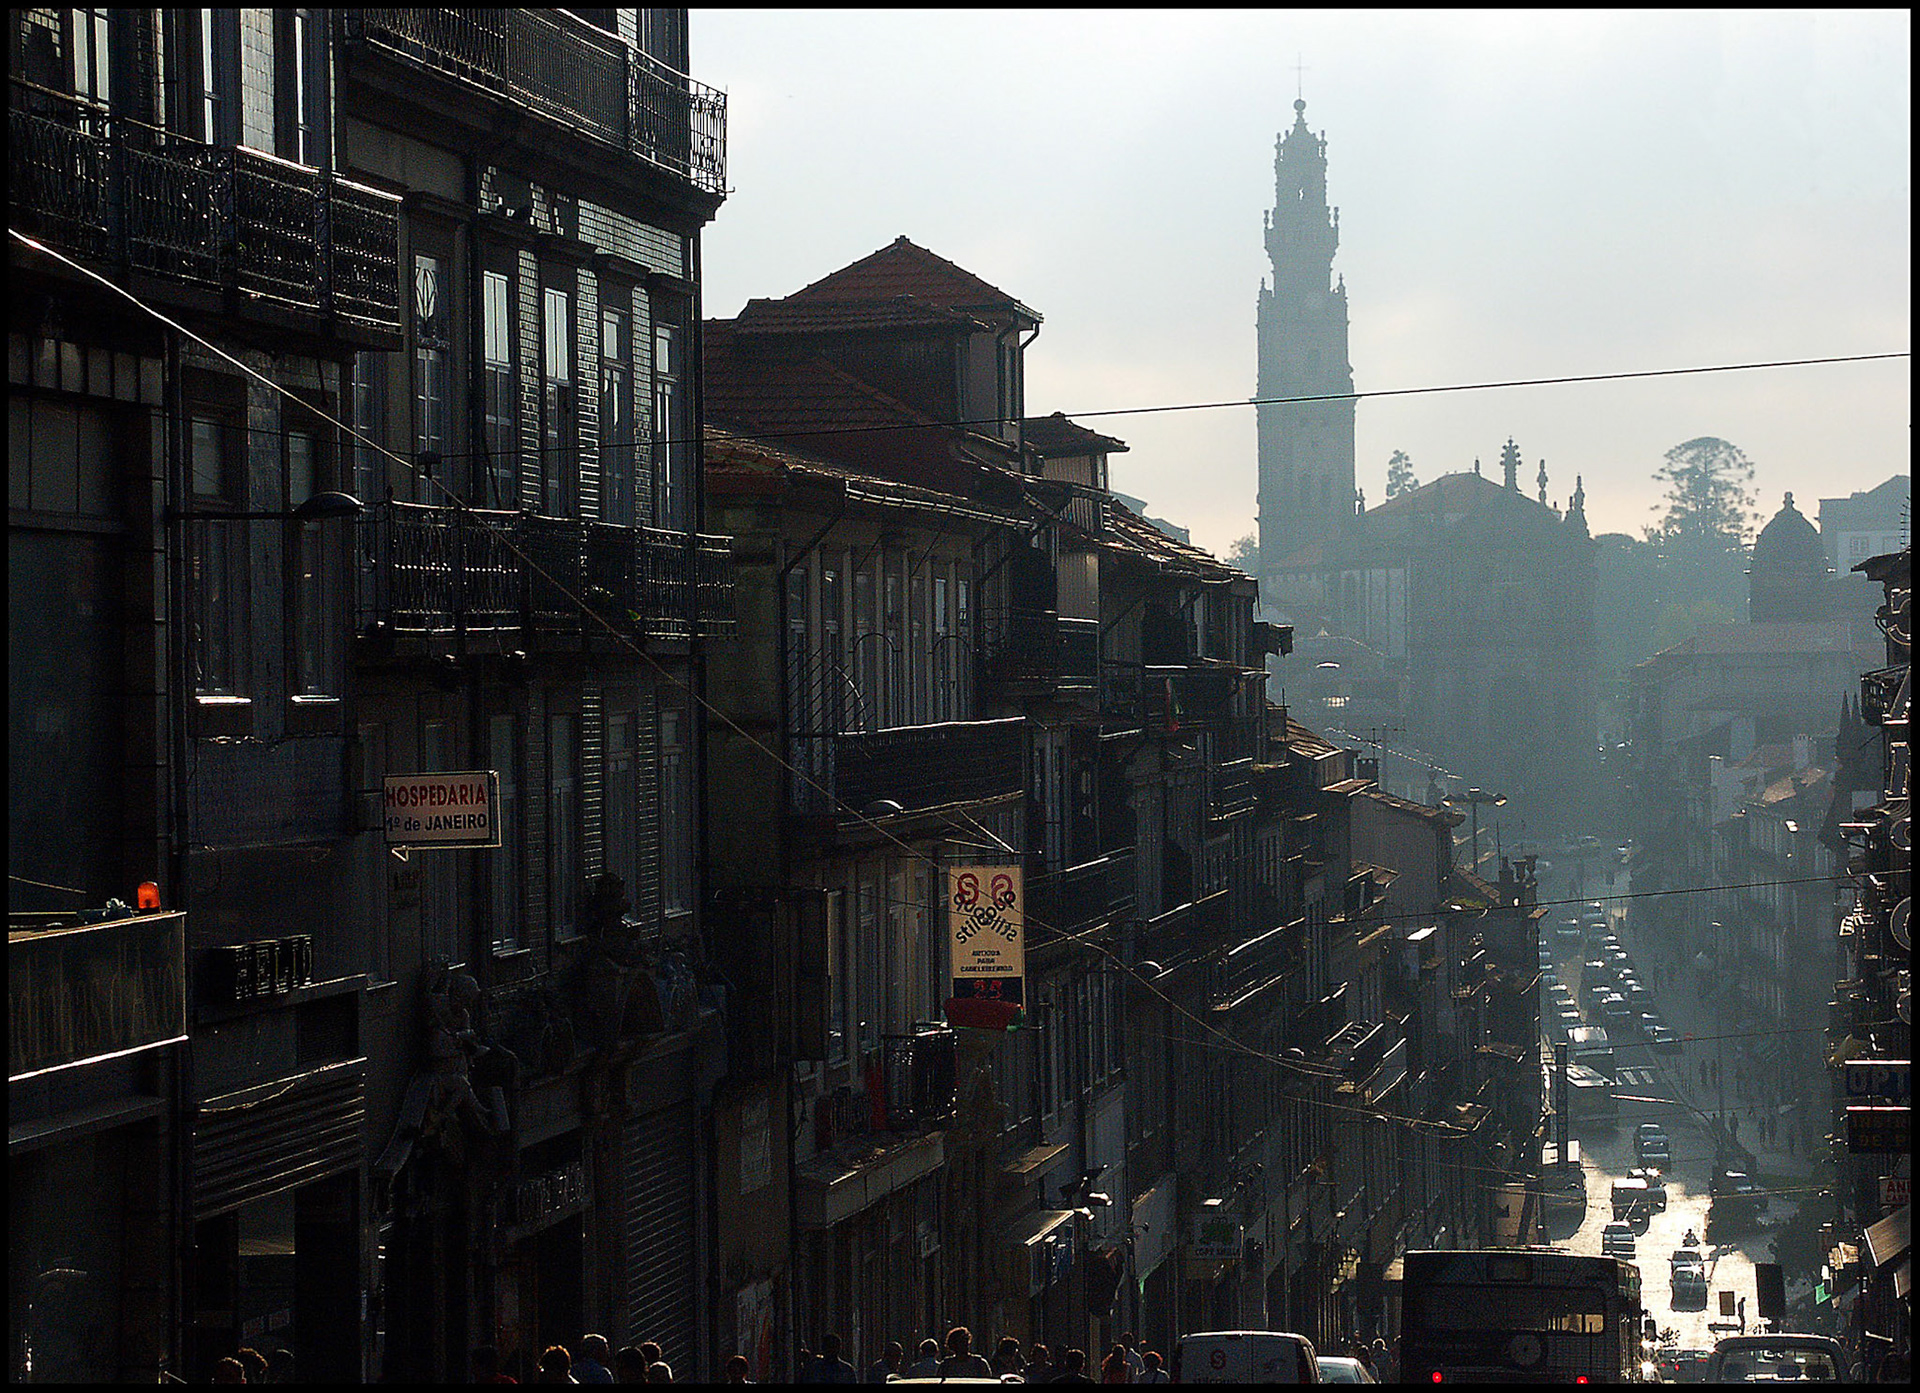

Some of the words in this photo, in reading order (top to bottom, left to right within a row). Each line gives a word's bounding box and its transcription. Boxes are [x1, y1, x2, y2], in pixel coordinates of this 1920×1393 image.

[385, 784, 488, 807] HOSPEDARIA
[404, 816, 421, 832] de
[425, 813, 488, 831] JANEIRO
